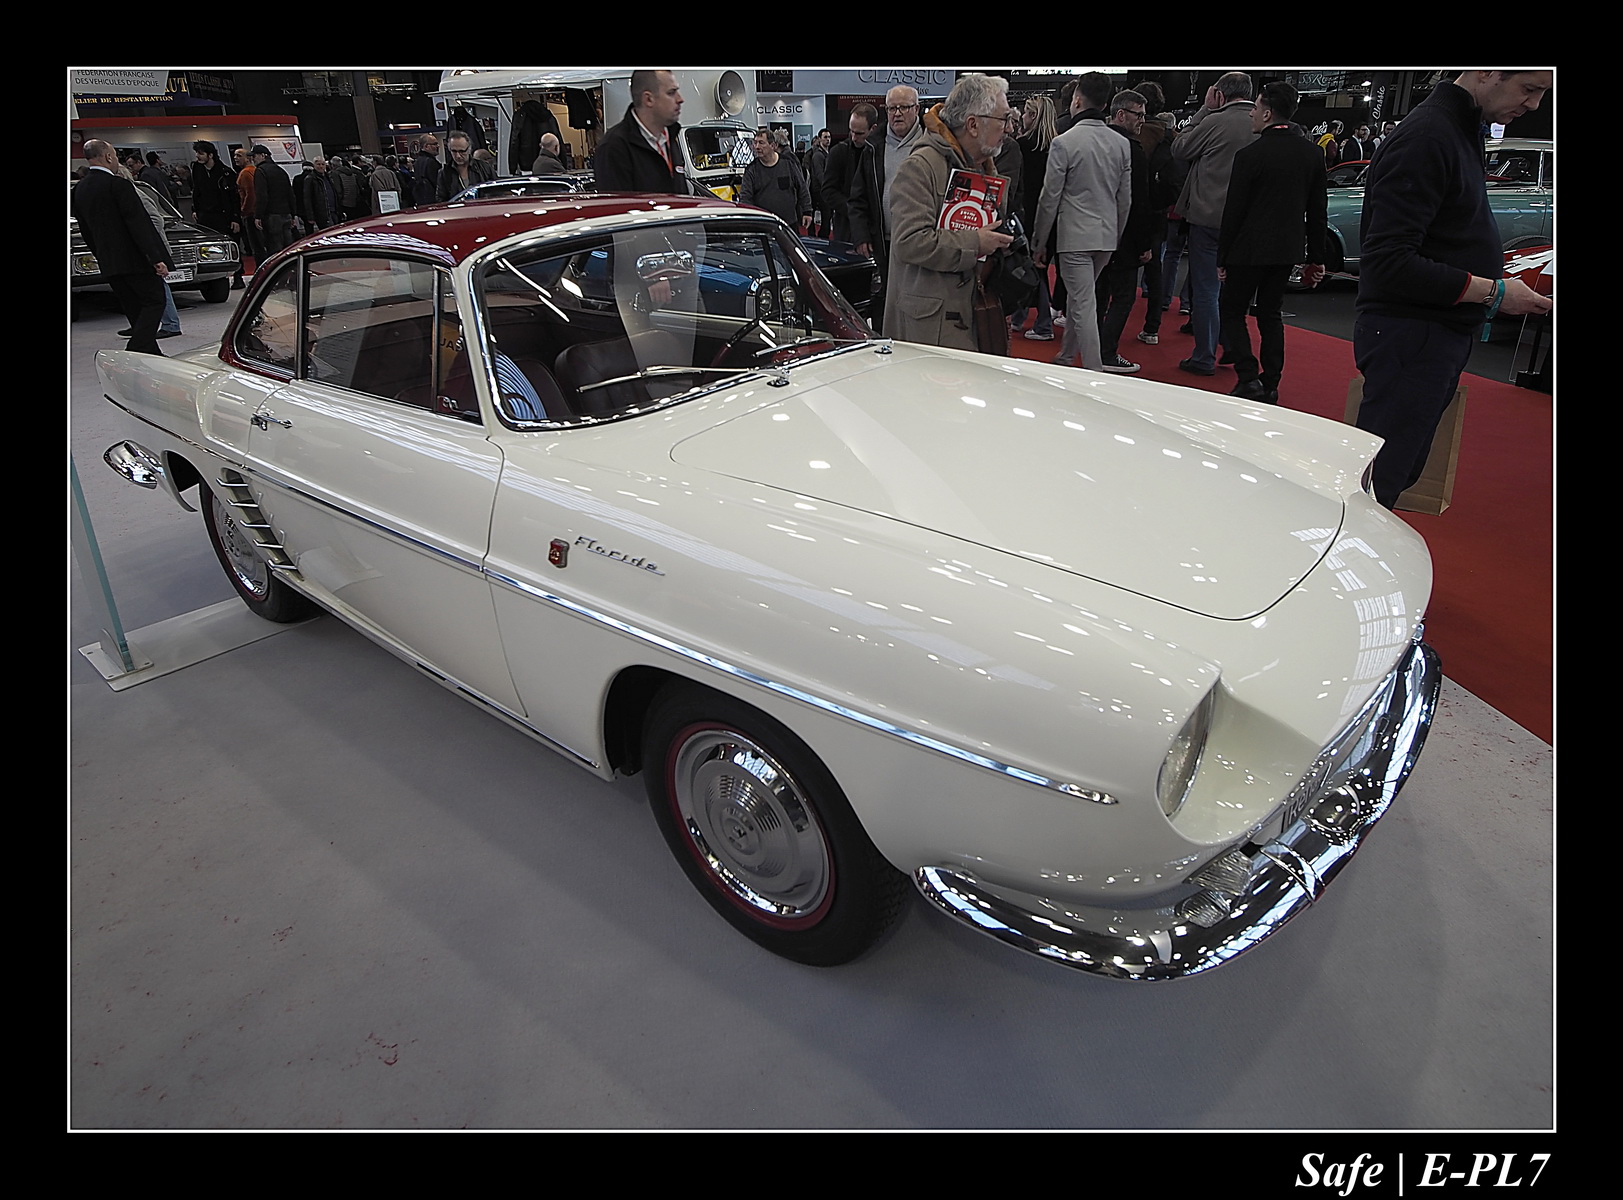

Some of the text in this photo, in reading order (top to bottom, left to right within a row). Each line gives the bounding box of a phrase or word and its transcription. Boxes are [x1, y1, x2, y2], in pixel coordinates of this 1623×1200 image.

[858, 70, 947, 85] CLASSIC
[114, 95, 174, 103] RESTAURATION
[756, 105, 803, 114] CLASSIC
[574, 535, 665, 577] Florida
